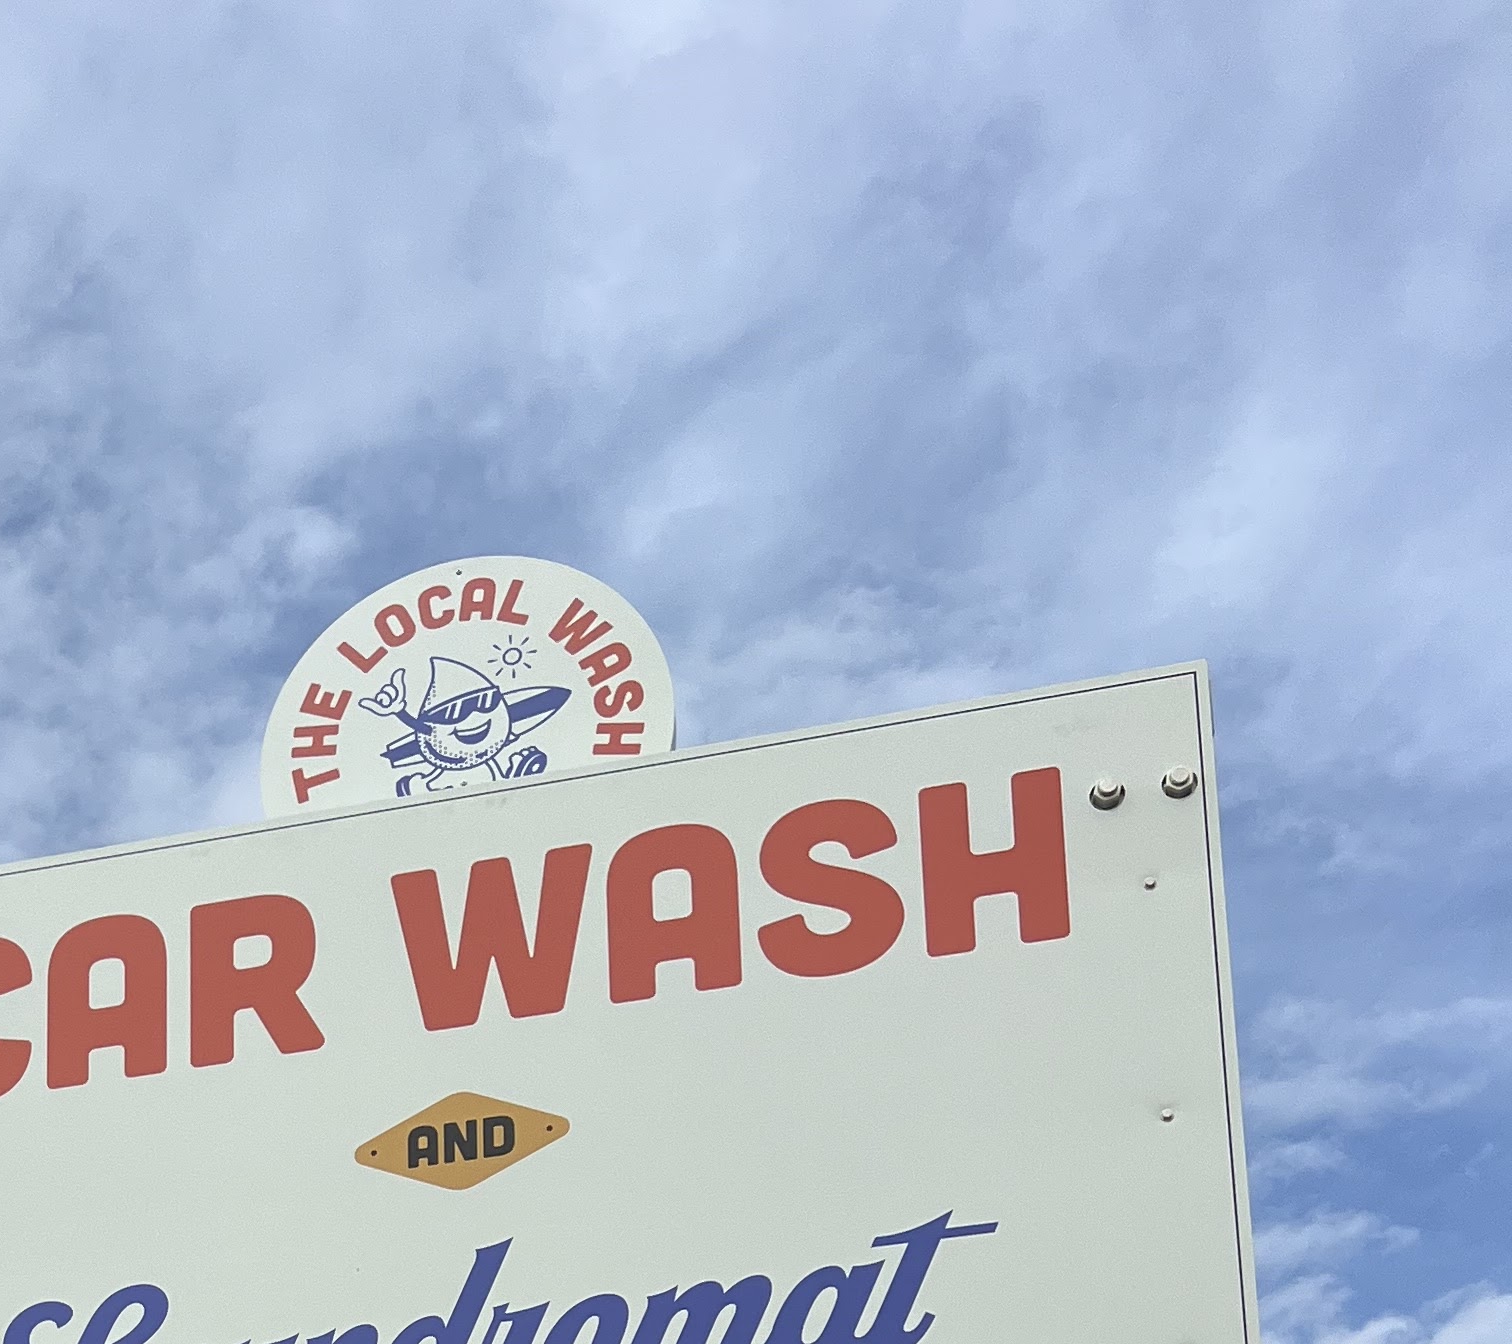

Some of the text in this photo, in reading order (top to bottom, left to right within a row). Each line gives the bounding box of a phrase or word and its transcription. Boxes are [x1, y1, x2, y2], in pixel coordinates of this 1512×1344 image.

[291, 577, 645, 803] THE LOCAL WASH
[390, 766, 1071, 1033] WASH
[406, 1114, 517, 1171] AND
